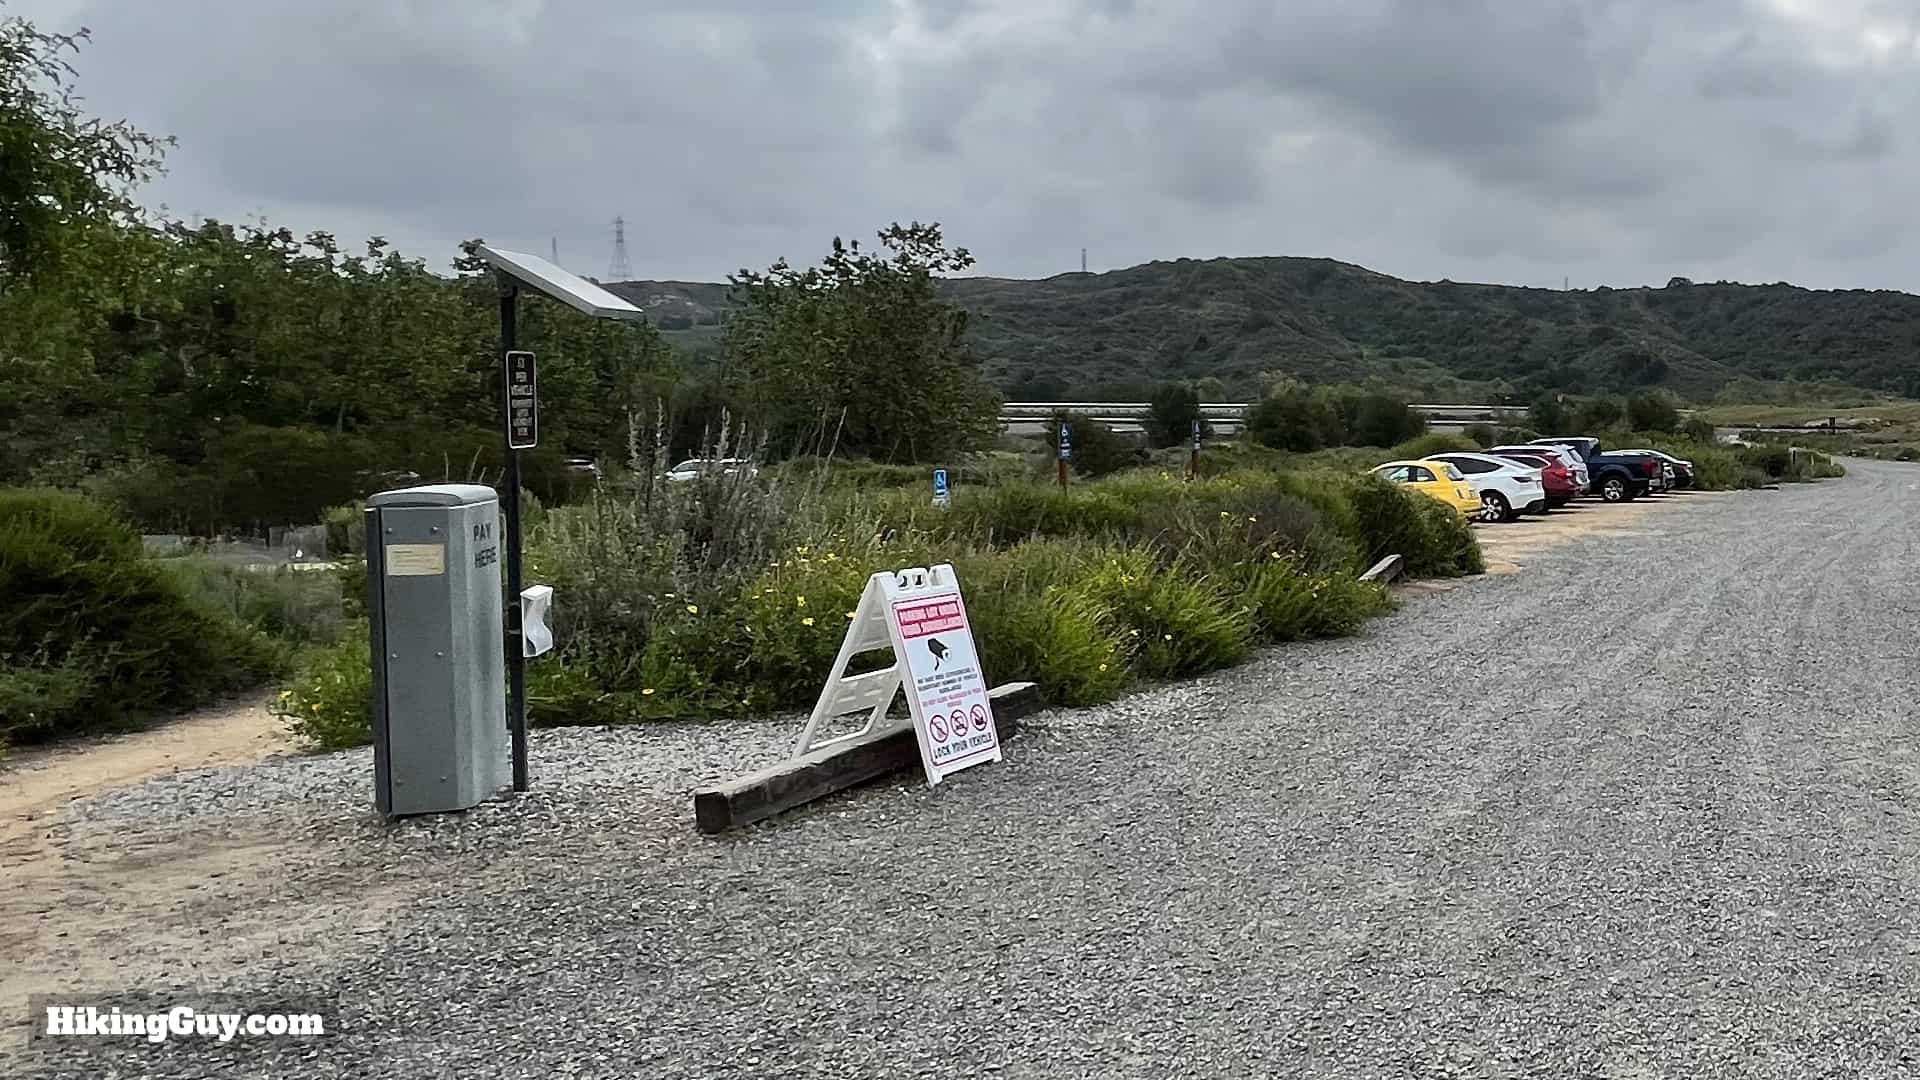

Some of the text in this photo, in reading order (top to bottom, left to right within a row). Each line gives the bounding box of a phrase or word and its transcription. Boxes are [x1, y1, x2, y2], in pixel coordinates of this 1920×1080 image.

[473, 522, 491, 541] PAY
[474, 546, 497, 568] HERE
[934, 732, 993, 759] LOCK YOUR VEHICLE
